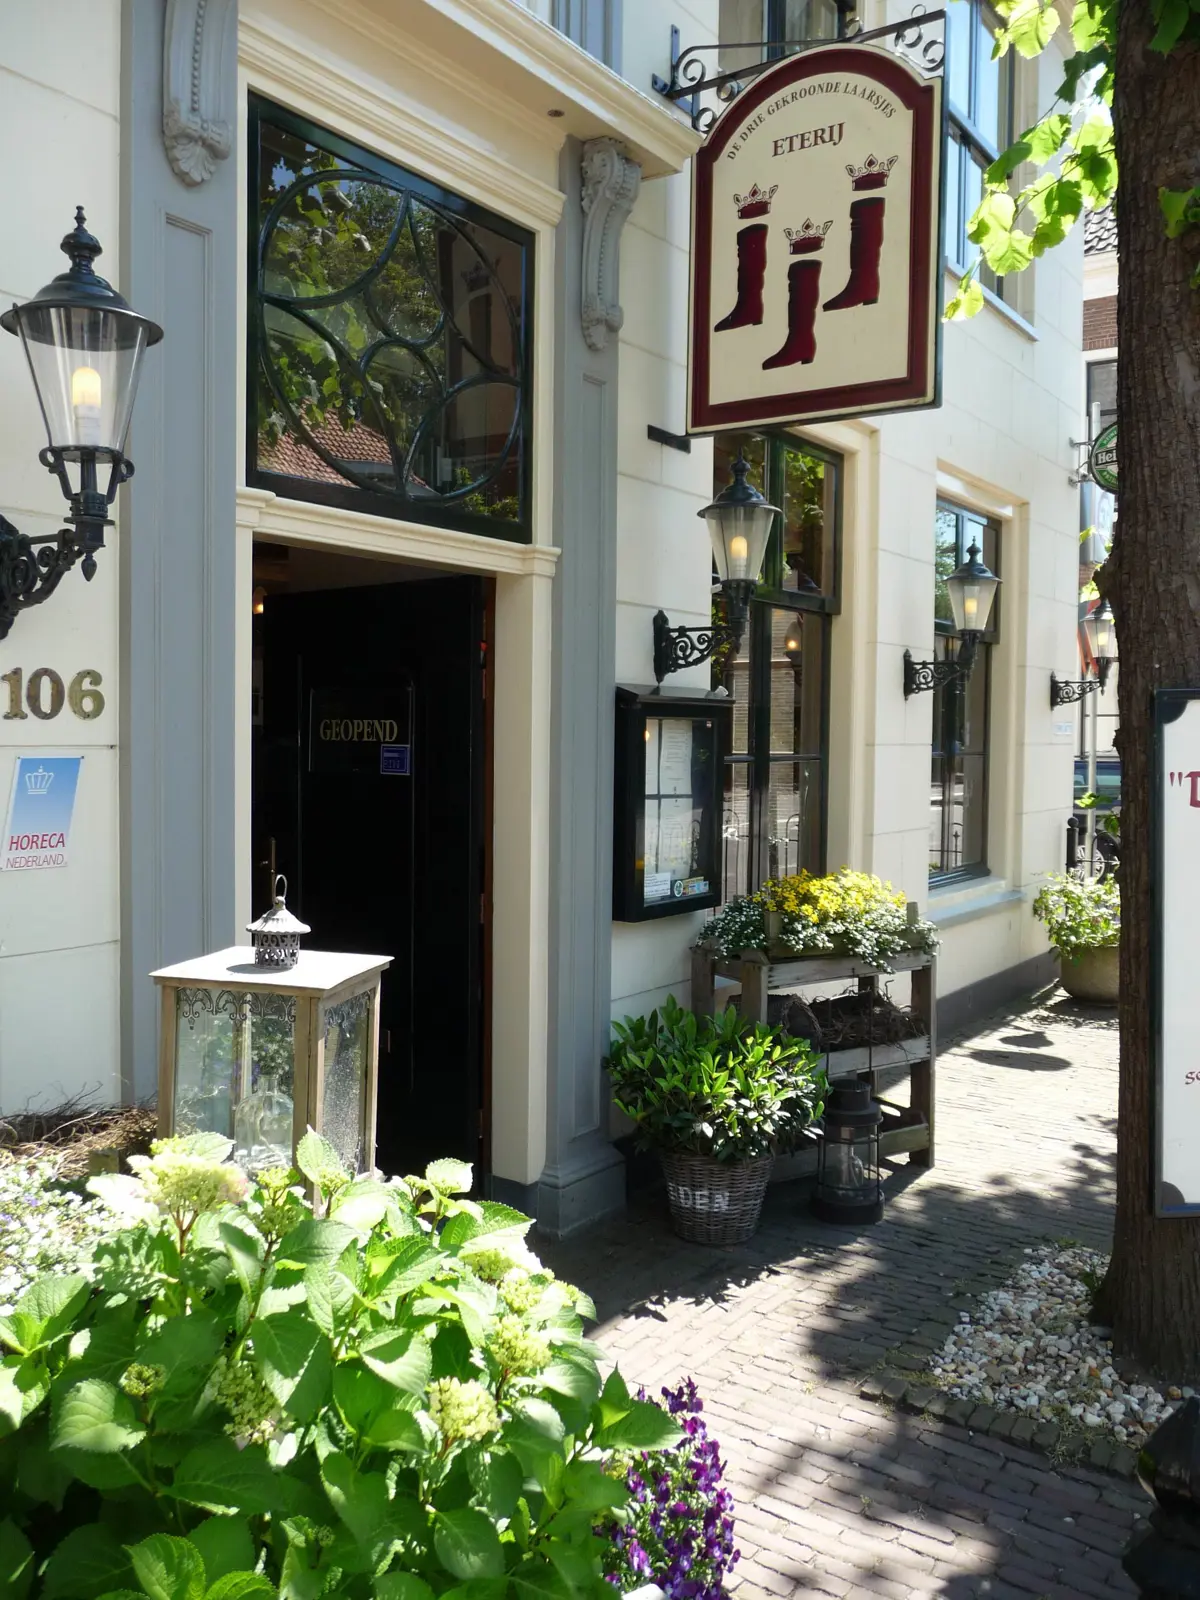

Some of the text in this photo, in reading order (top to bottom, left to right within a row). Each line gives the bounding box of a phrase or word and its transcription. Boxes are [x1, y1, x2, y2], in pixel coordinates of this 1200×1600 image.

[727, 142, 742, 161] DE
[740, 113, 766, 142] DRIE
[767, 81, 841, 116] GEKROONDE
[772, 122, 846, 158] ETERIJ
[1, 667, 106, 720] 106
[319, 719, 398, 742] GEOPEND
[9, 833, 66, 851] HORECA
[6, 853, 65, 869] NEDERLAND
